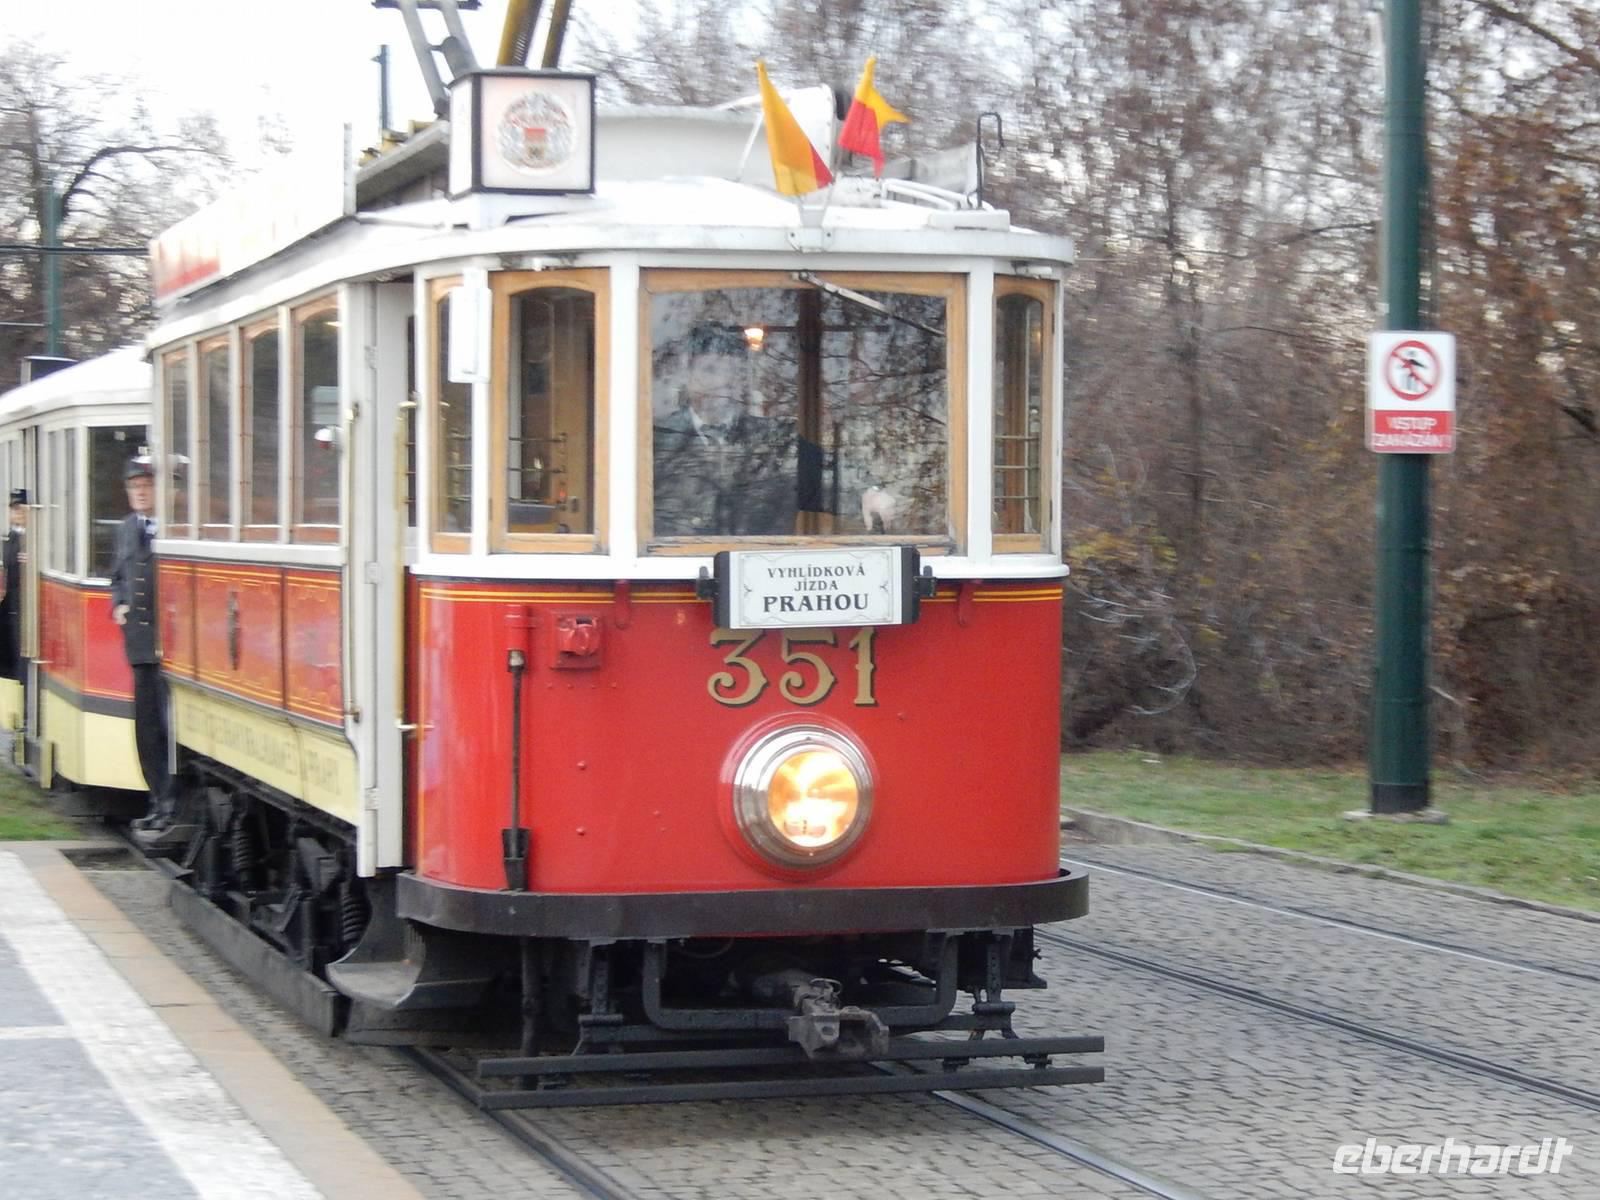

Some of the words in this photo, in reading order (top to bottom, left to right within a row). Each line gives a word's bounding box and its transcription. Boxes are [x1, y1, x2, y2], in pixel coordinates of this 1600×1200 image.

[767, 562, 866, 578] VYHLÍDKOVÁ
[794, 579, 839, 591] JÍZDA
[763, 592, 869, 613] PRAHOU
[707, 627, 877, 706] 351
